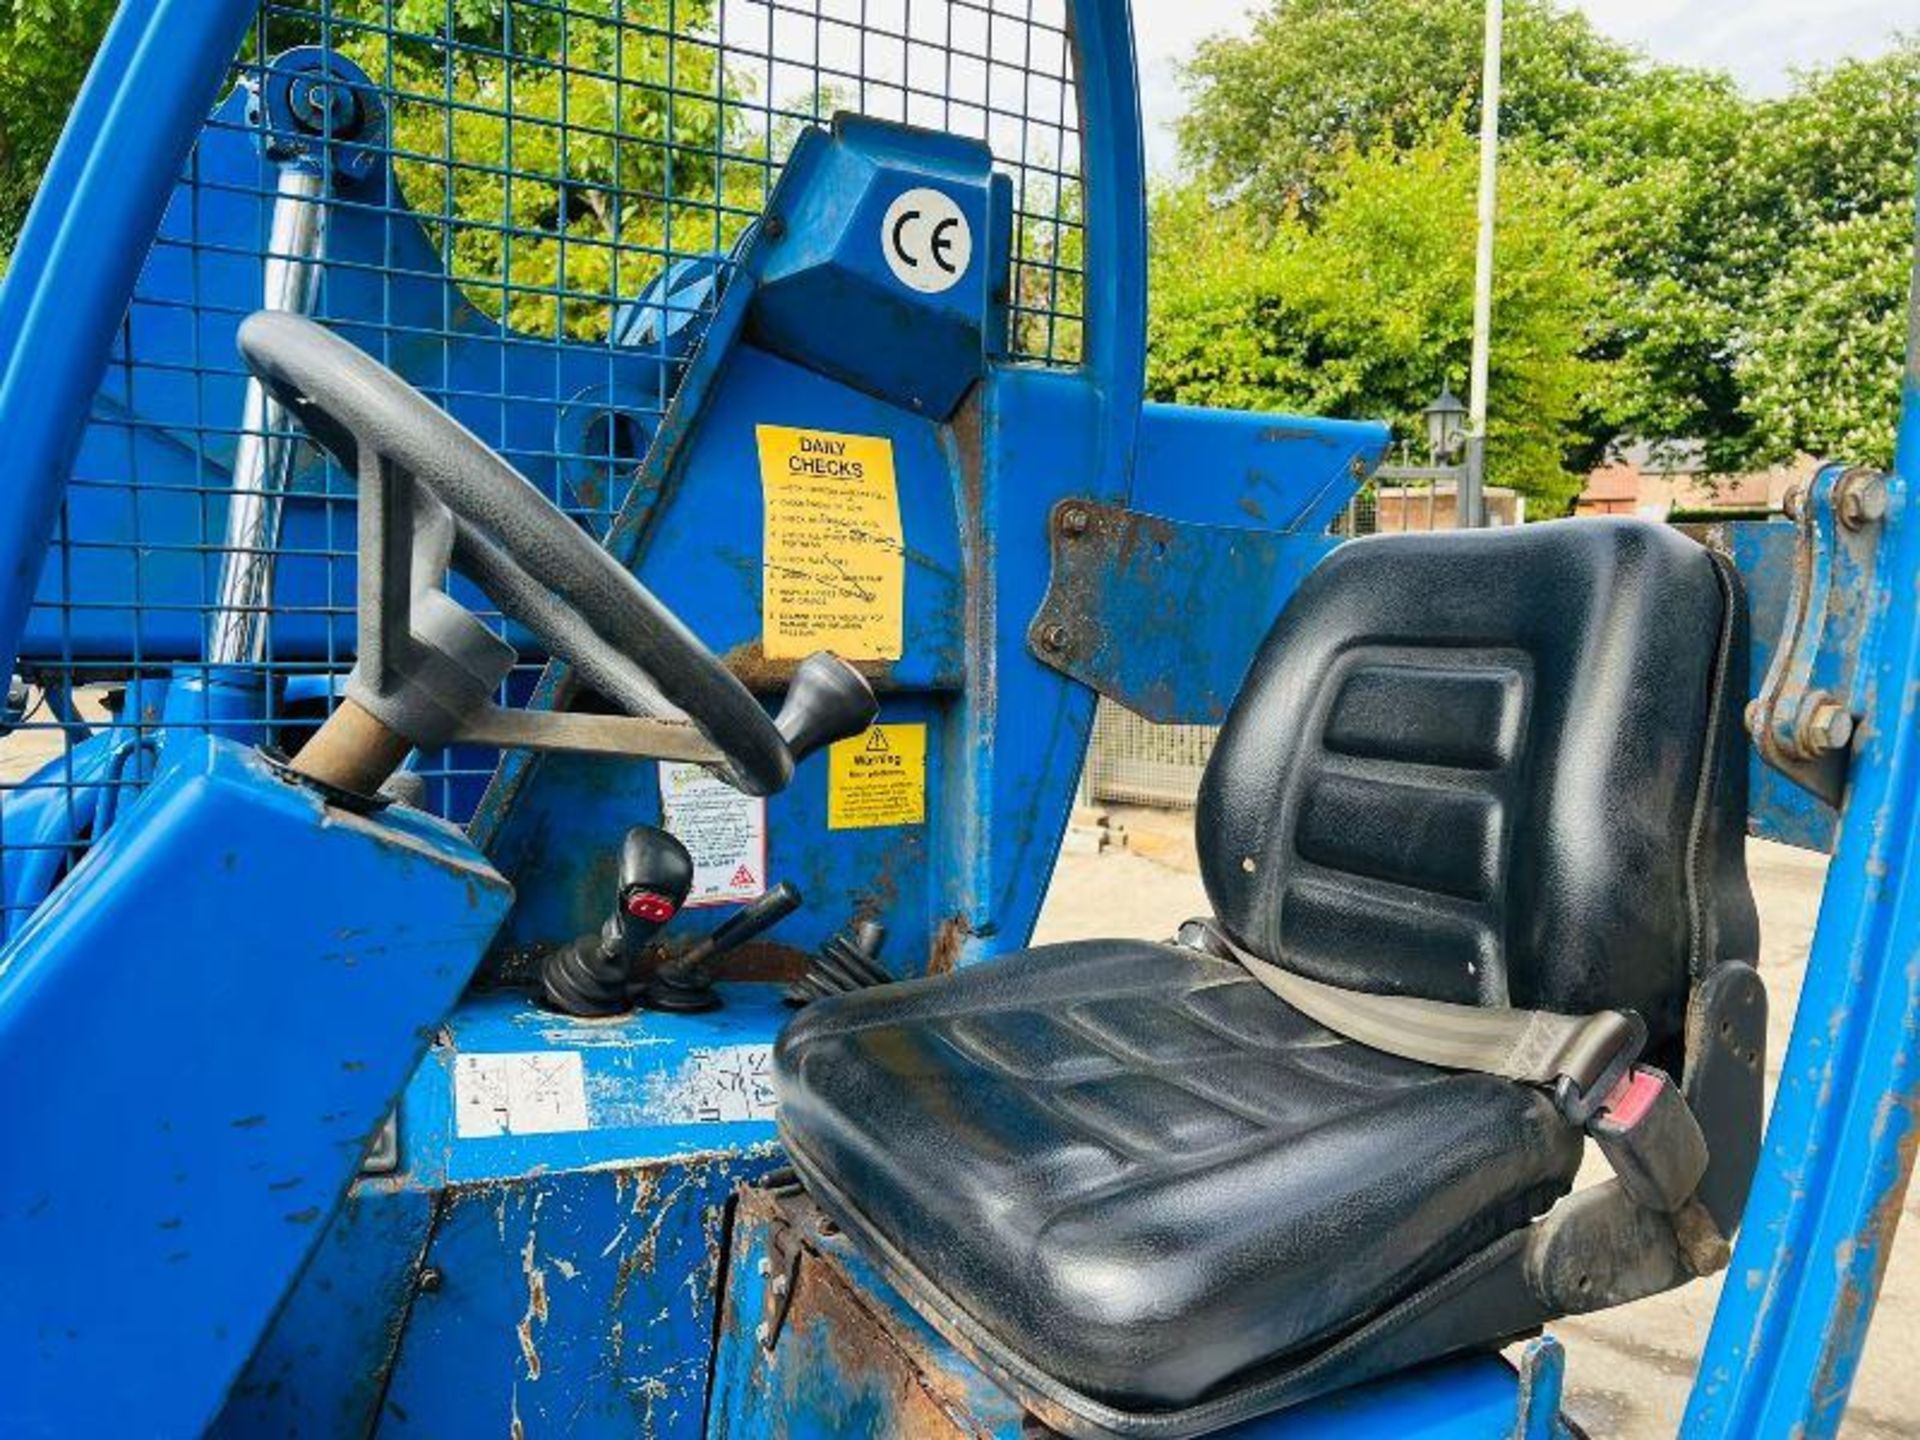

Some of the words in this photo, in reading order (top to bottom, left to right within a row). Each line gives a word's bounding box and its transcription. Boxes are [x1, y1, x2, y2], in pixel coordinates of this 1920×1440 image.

[893, 211, 958, 274] CE
[800, 437, 846, 456] DAILY
[788, 456, 864, 478] CHECKS
